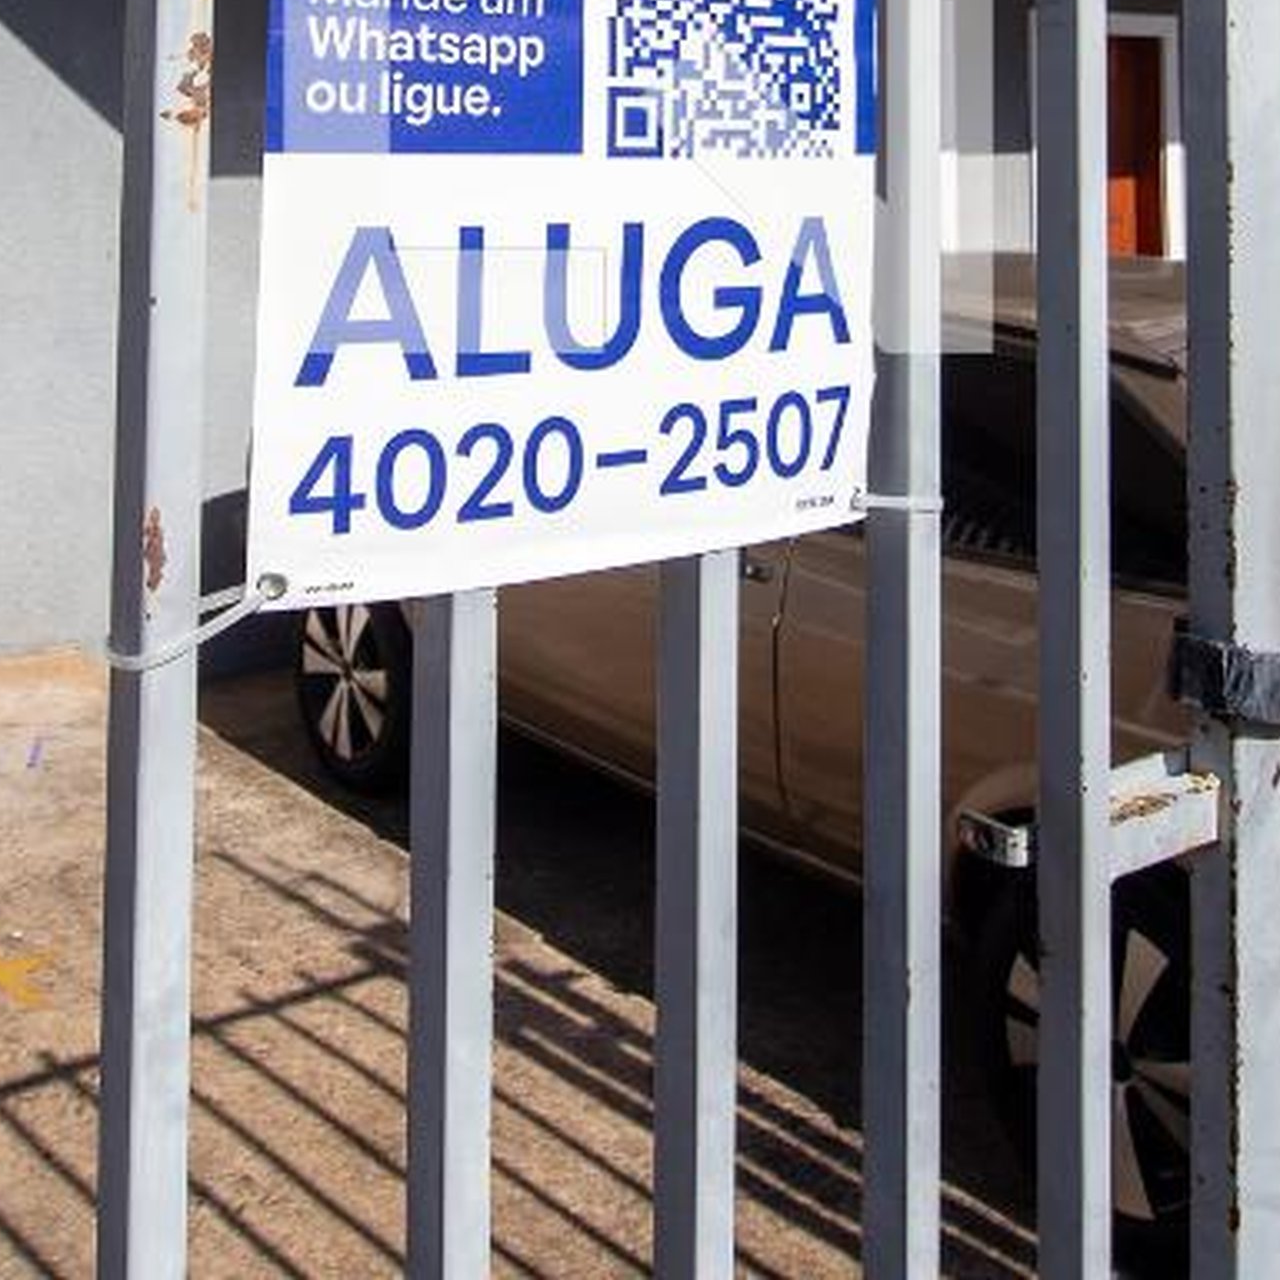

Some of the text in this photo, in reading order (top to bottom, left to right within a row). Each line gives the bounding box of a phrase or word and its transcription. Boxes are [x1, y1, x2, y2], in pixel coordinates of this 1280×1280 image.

[305, 70, 502, 126] ou ligue.
[307, 15, 545, 77] Whatsapp
[291, 215, 853, 388] ALUGA
[287, 384, 853, 536] 4020-2507
